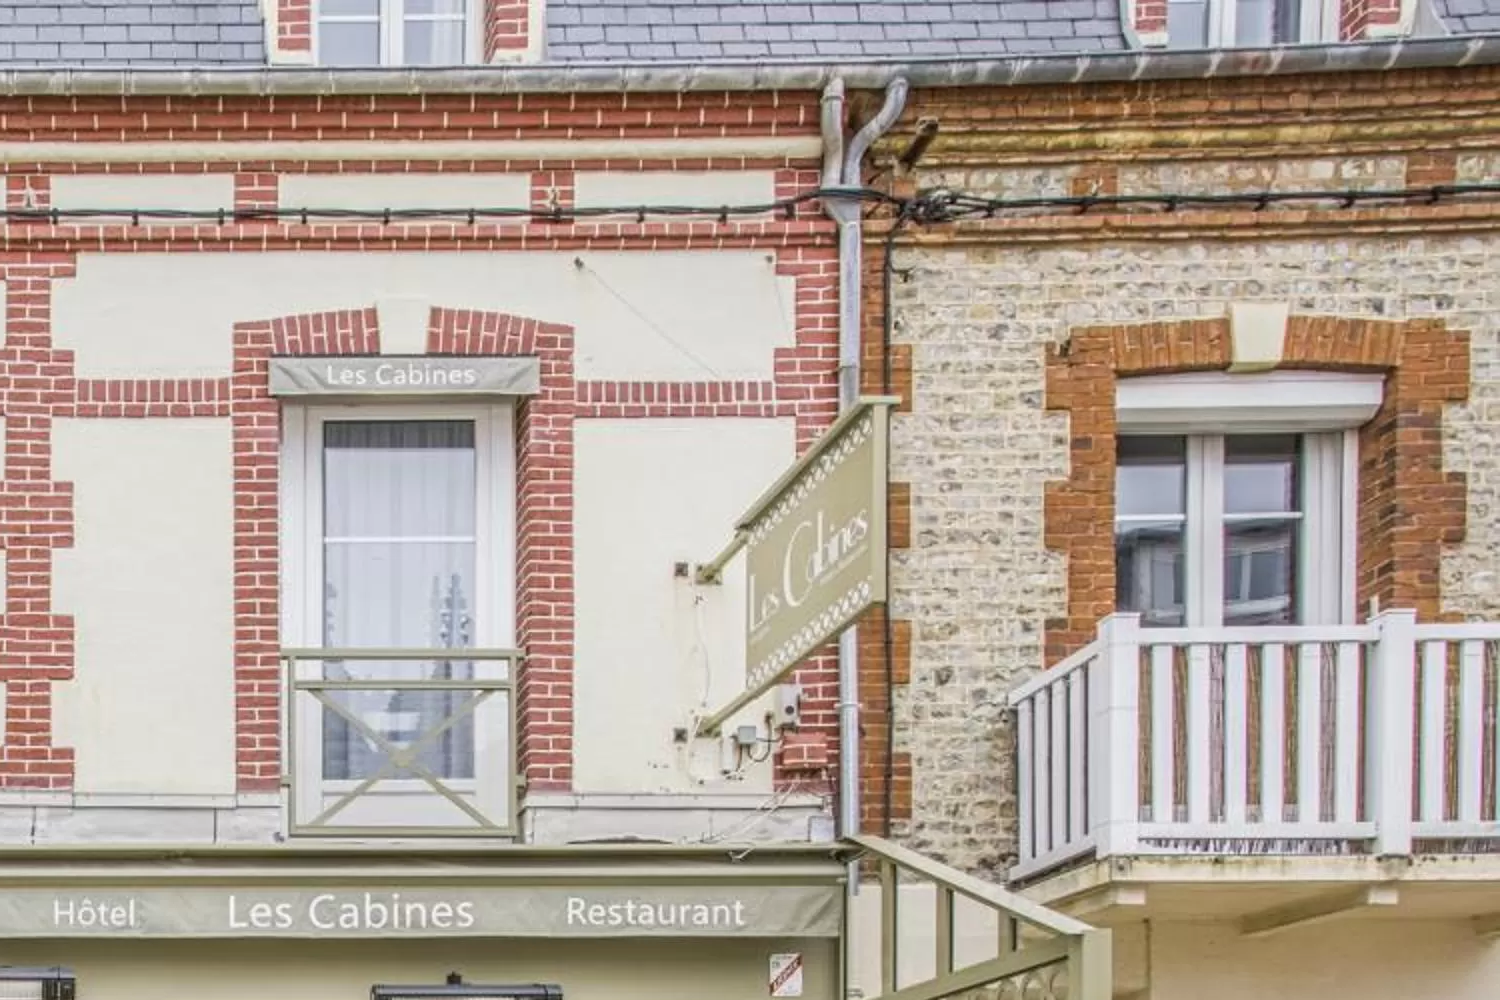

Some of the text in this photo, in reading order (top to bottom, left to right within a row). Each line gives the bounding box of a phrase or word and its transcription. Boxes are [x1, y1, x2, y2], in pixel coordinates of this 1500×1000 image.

[325, 364, 477, 387] Les Cabines
[54, 897, 137, 928] Hôtel
[229, 894, 293, 929] Les
[309, 892, 475, 930] Cabines
[567, 897, 746, 927] Restaurant
